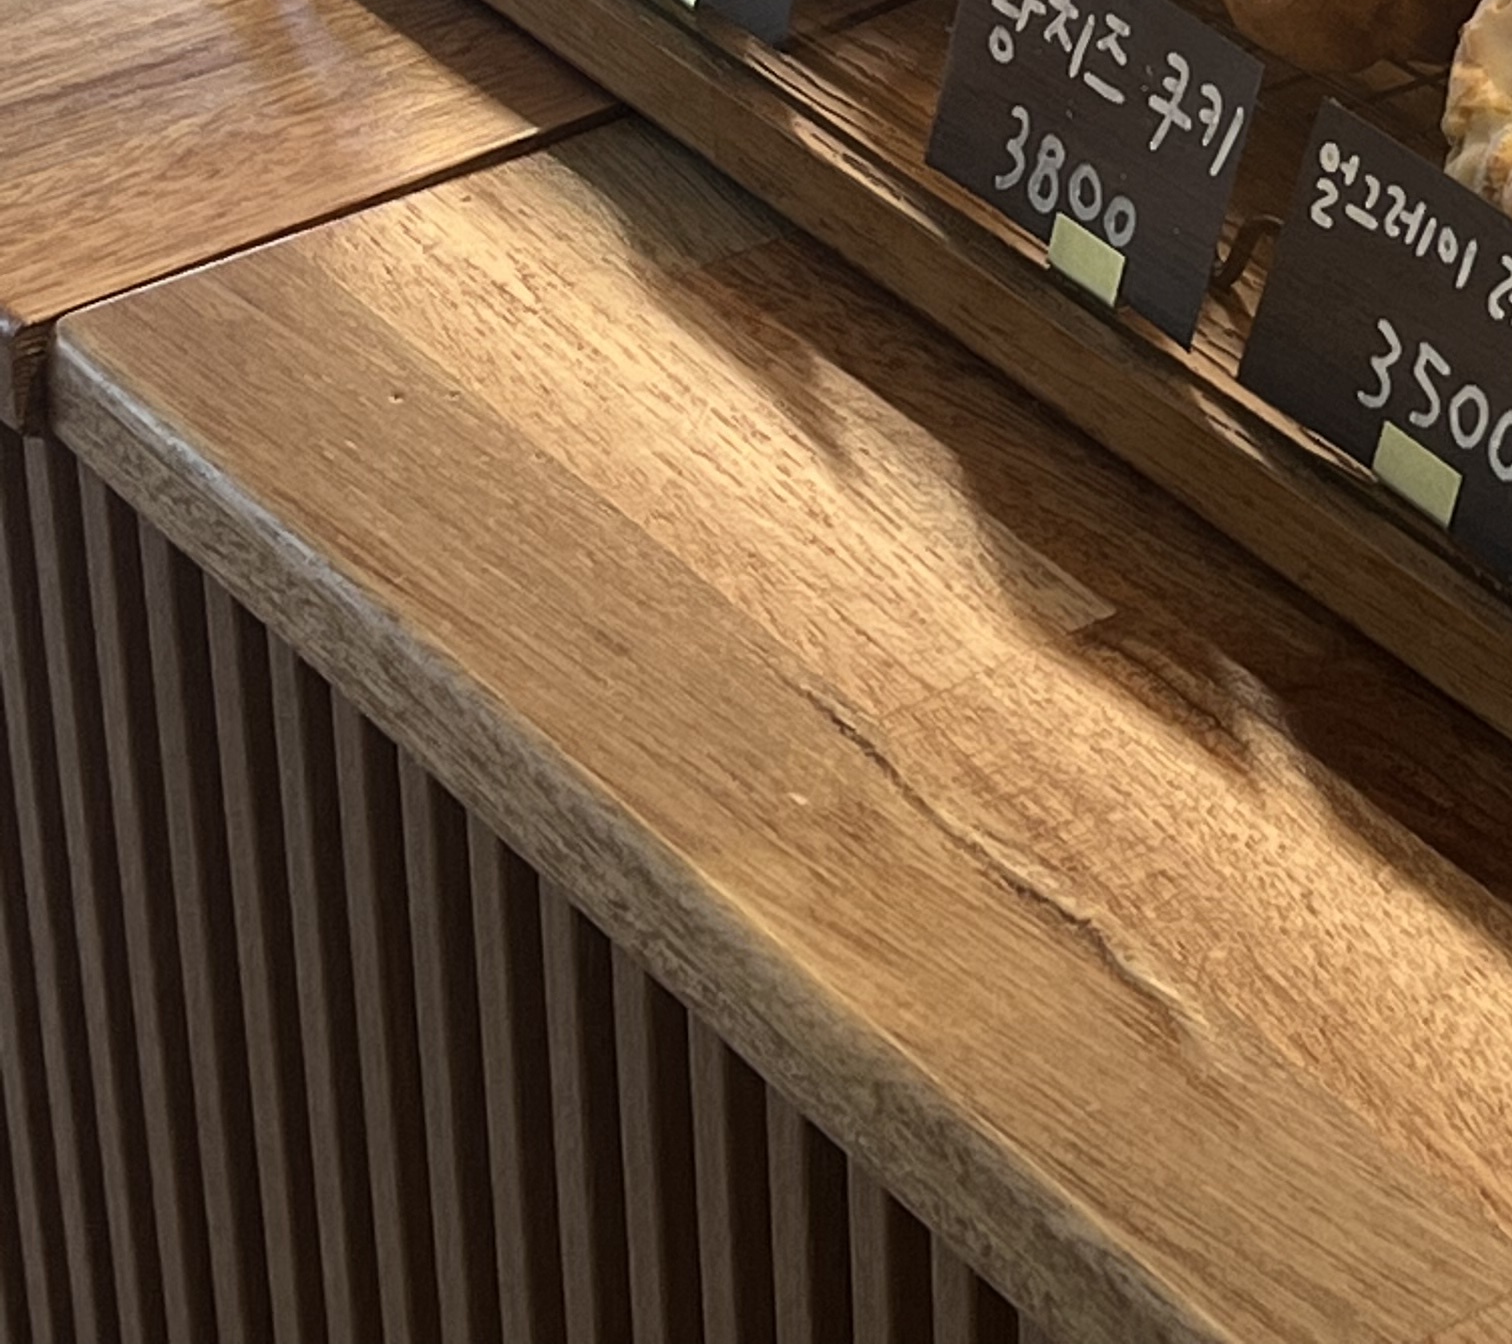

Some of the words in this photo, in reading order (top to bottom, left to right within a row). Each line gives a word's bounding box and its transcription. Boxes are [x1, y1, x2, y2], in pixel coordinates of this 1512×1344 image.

[994, 106, 1136, 247] 3800
[1149, 52, 1244, 176] 쿠키
[1310, 142, 1477, 289] 얼그레이
